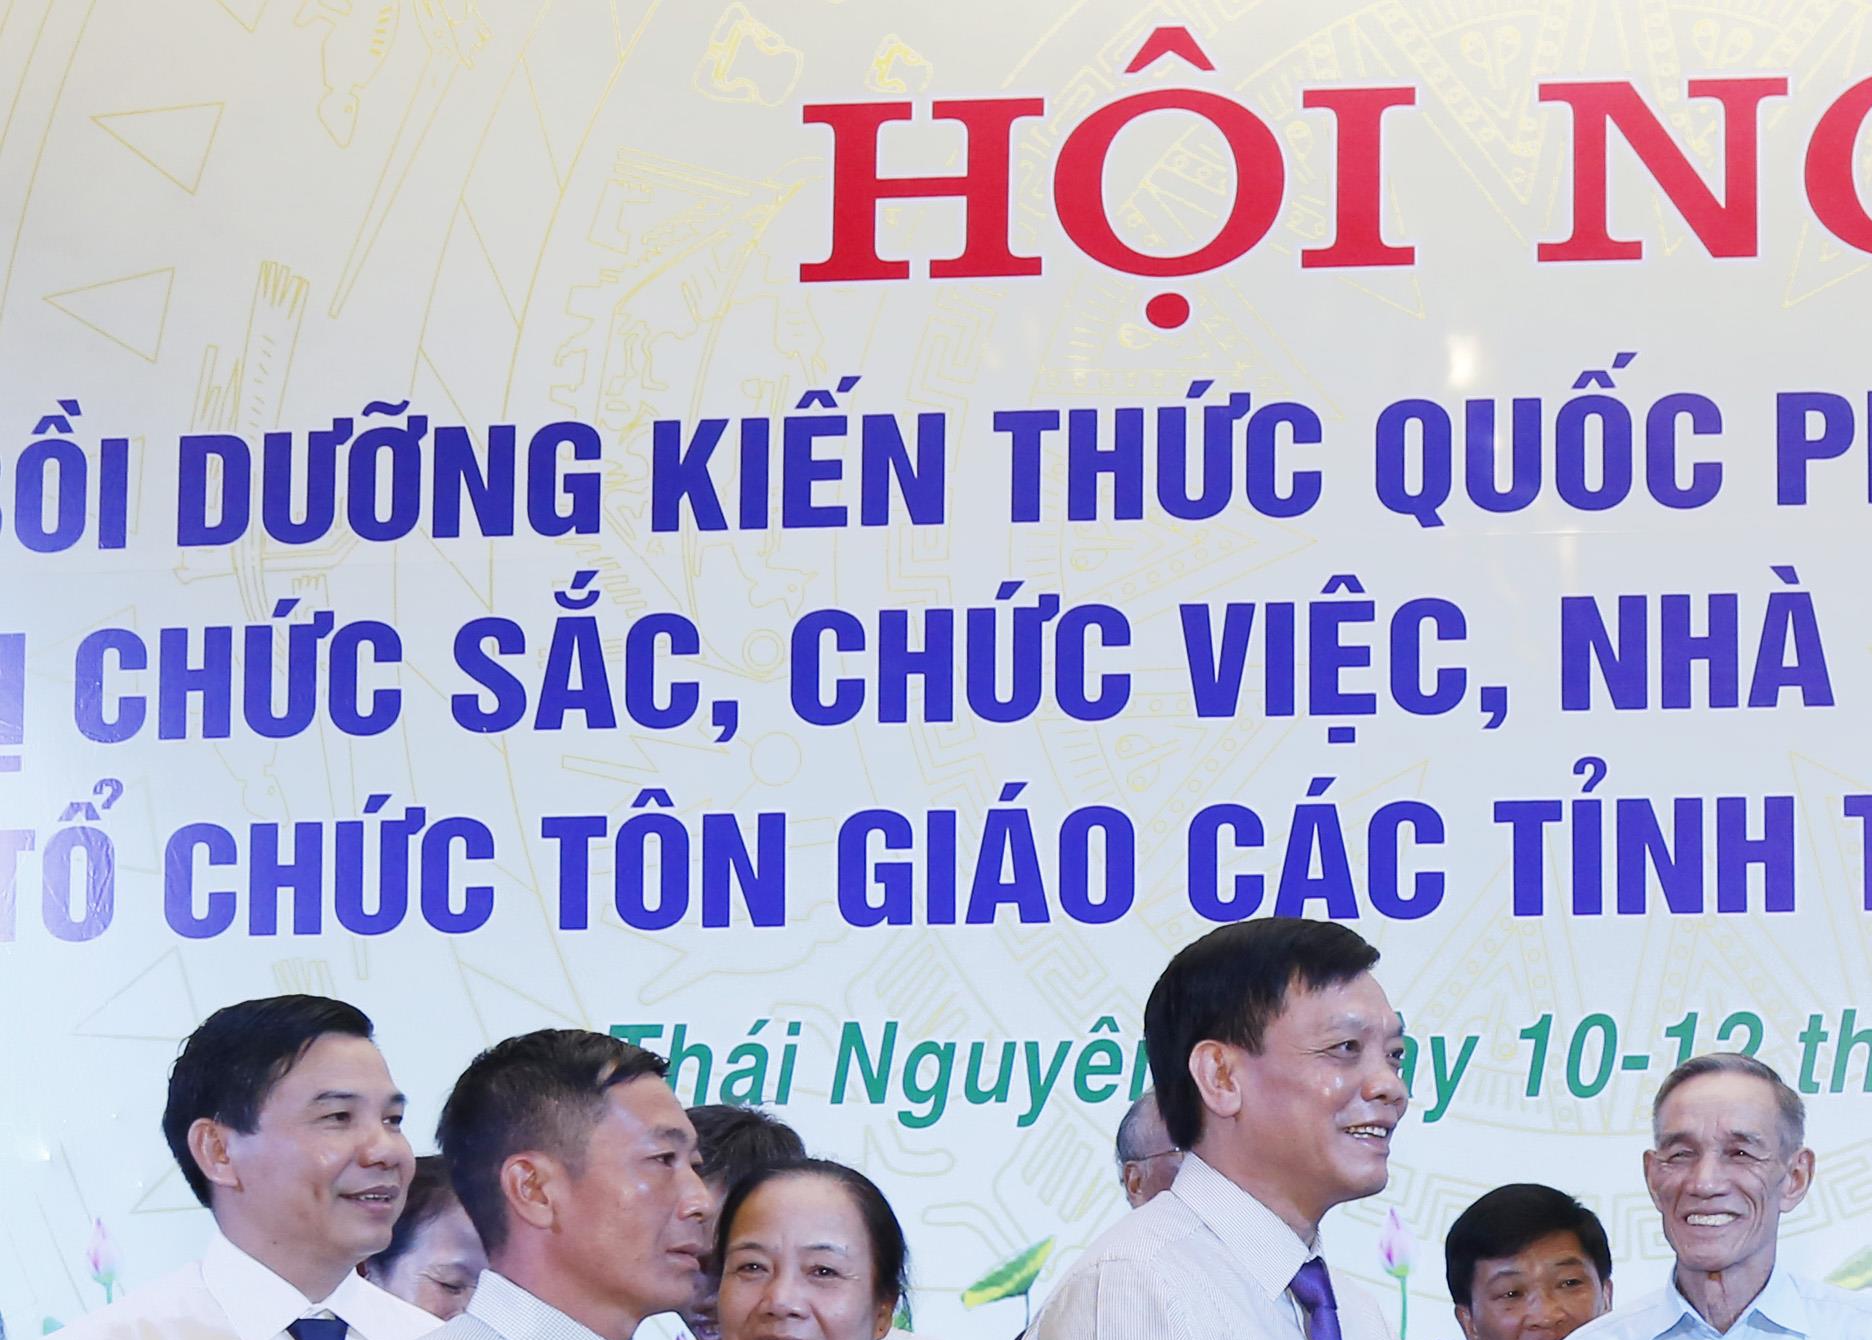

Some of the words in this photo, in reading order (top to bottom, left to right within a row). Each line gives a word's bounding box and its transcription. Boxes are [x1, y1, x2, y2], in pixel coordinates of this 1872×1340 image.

[800, 26, 1415, 329] HỘI
[0, 399, 130, 554] ỒI
[176, 399, 602, 548] DƯỠNG
[651, 375, 946, 534] KIẾN
[993, 379, 1323, 524] THỨC
[1375, 351, 1723, 529] QUỐC
[75, 597, 403, 744] CHỨC
[451, 569, 739, 744] SẮC,
[790, 580, 1132, 727] CHỨC
[1179, 574, 1508, 745] VIỆC,
[1561, 565, 1835, 712] NHÀ
[164, 793, 496, 940] CHỨC
[540, 787, 787, 932] TÔN
[837, 781, 1136, 929] GIÁO
[1187, 776, 1446, 924] CÁC
[1493, 755, 1796, 918] TỈNH
